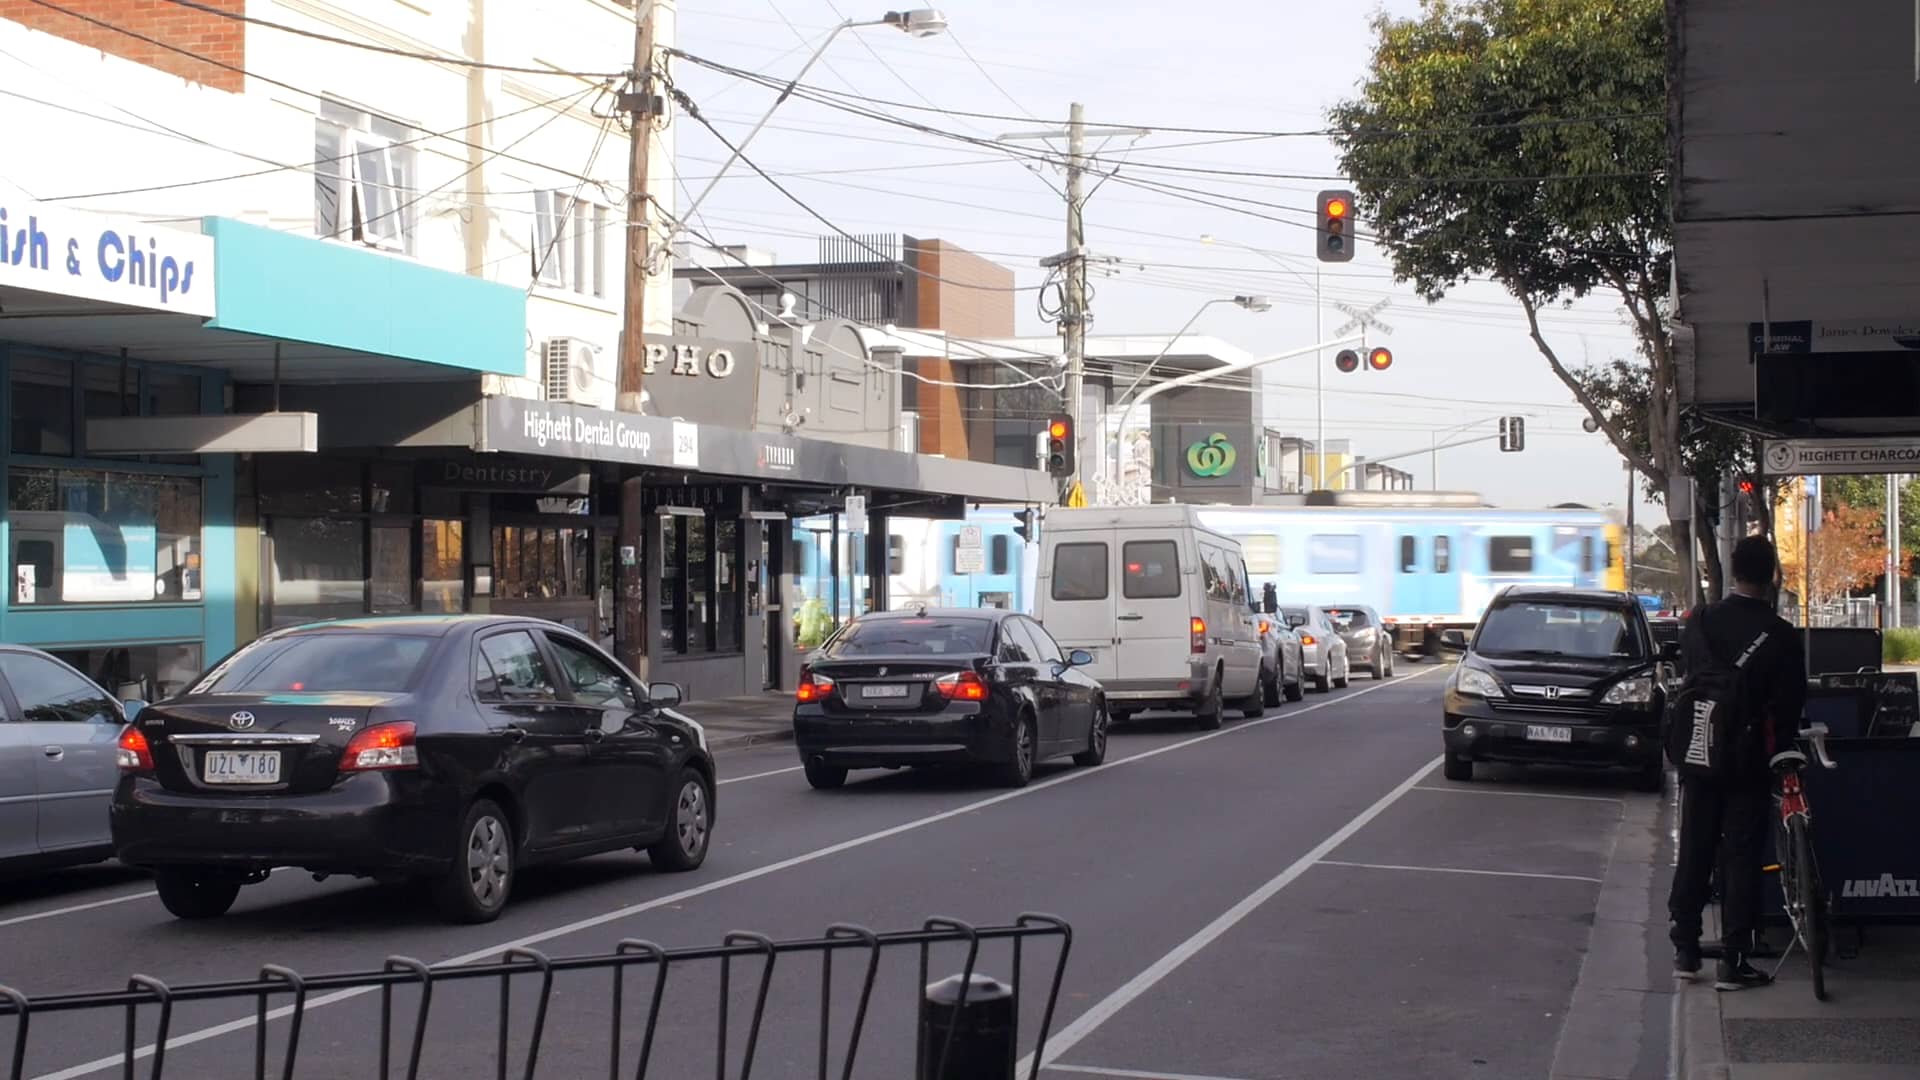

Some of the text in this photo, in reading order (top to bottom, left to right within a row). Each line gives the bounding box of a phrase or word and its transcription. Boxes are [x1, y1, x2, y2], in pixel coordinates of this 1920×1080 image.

[66, 237, 81, 276] &
[97, 230, 193, 304] Chips
[641, 343, 735, 379] PHO
[524, 410, 651, 457] Highett Dental Group
[679, 435, 693, 454] 294
[1799, 450, 1856, 462] HIGHETT
[446, 462, 552, 488] Dentistry
[209, 756, 276, 775] UZL 180
